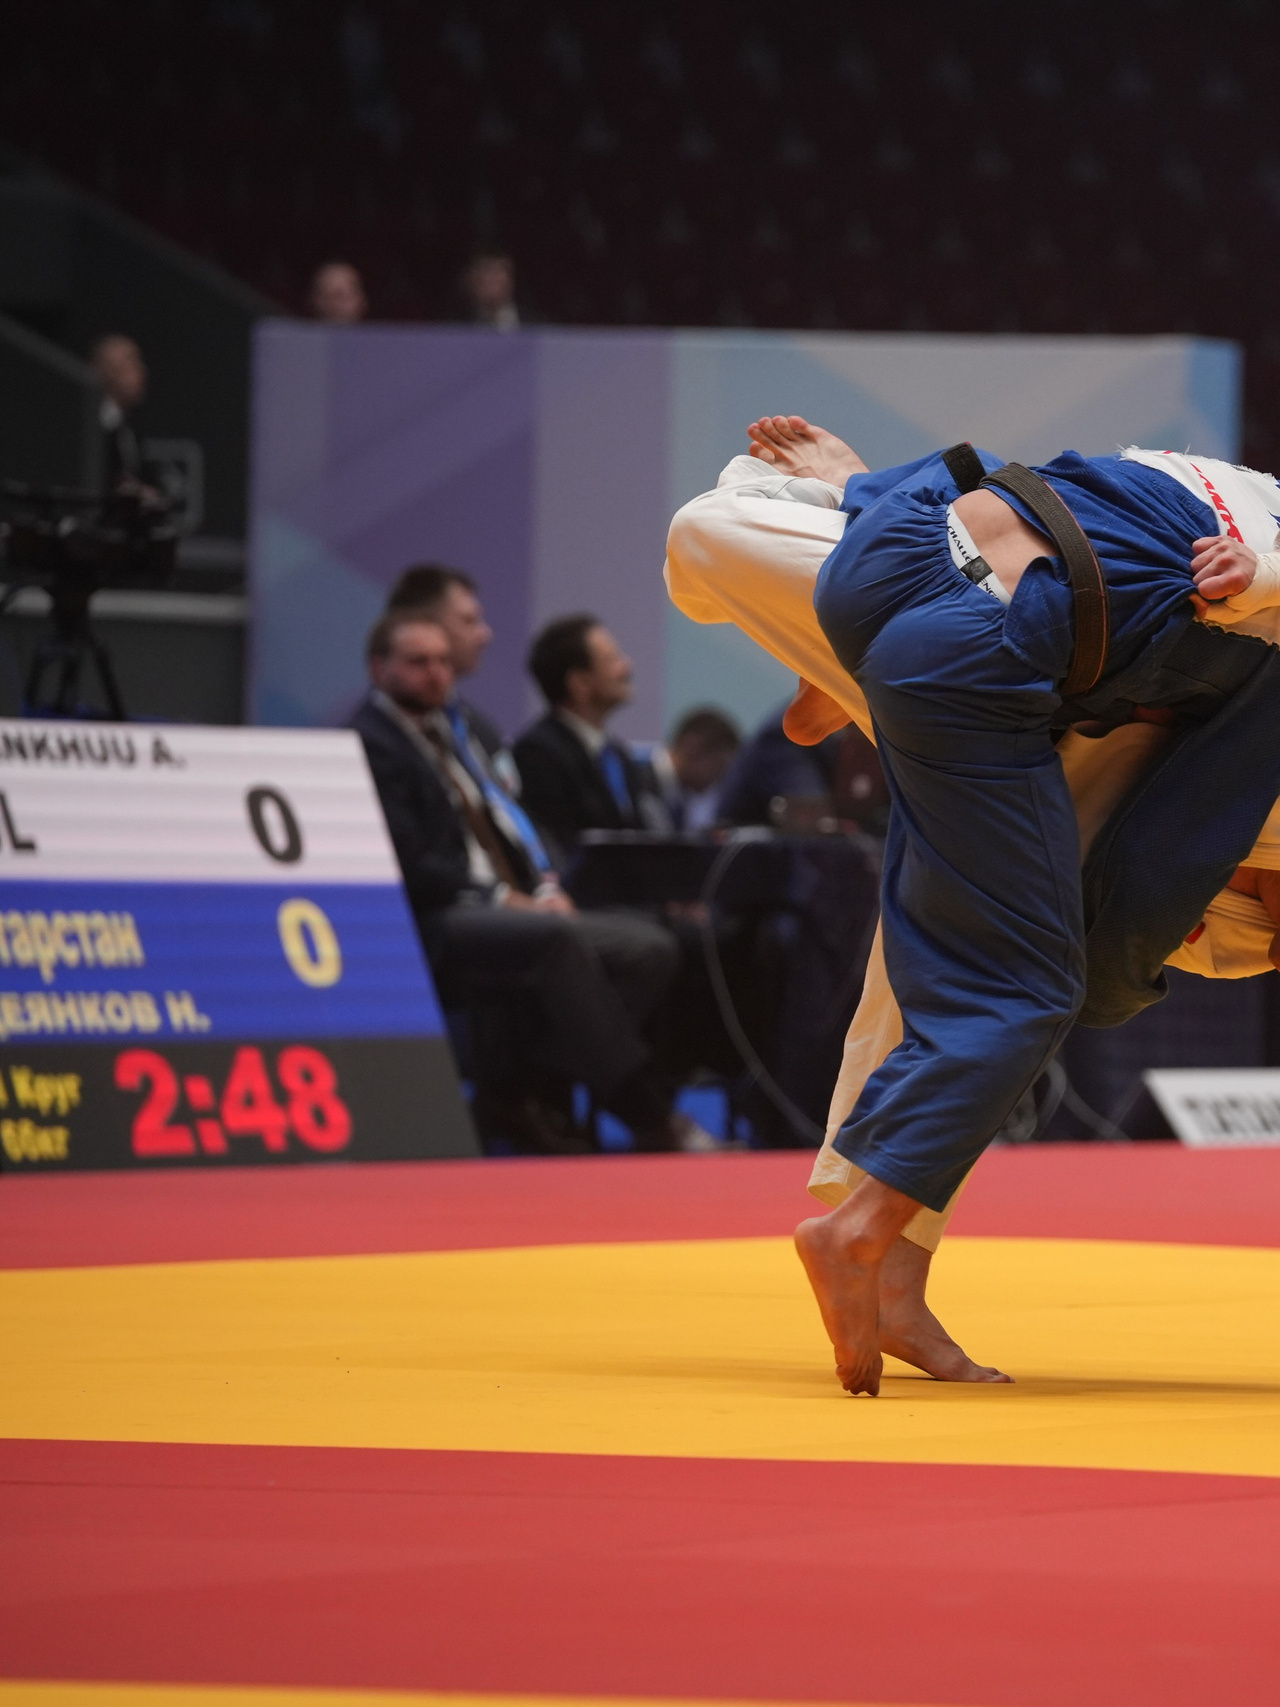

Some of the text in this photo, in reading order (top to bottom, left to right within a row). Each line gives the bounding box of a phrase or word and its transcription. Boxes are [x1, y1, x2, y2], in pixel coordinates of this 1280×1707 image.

[0, 731, 138, 767] NKHUU
[0, 789, 37, 851] L
[246, 784, 304, 865] 0
[277, 898, 343, 988] 0
[0, 990, 161, 1038] ЕЯНКОВ
[113, 1045, 353, 1157] 2:48
